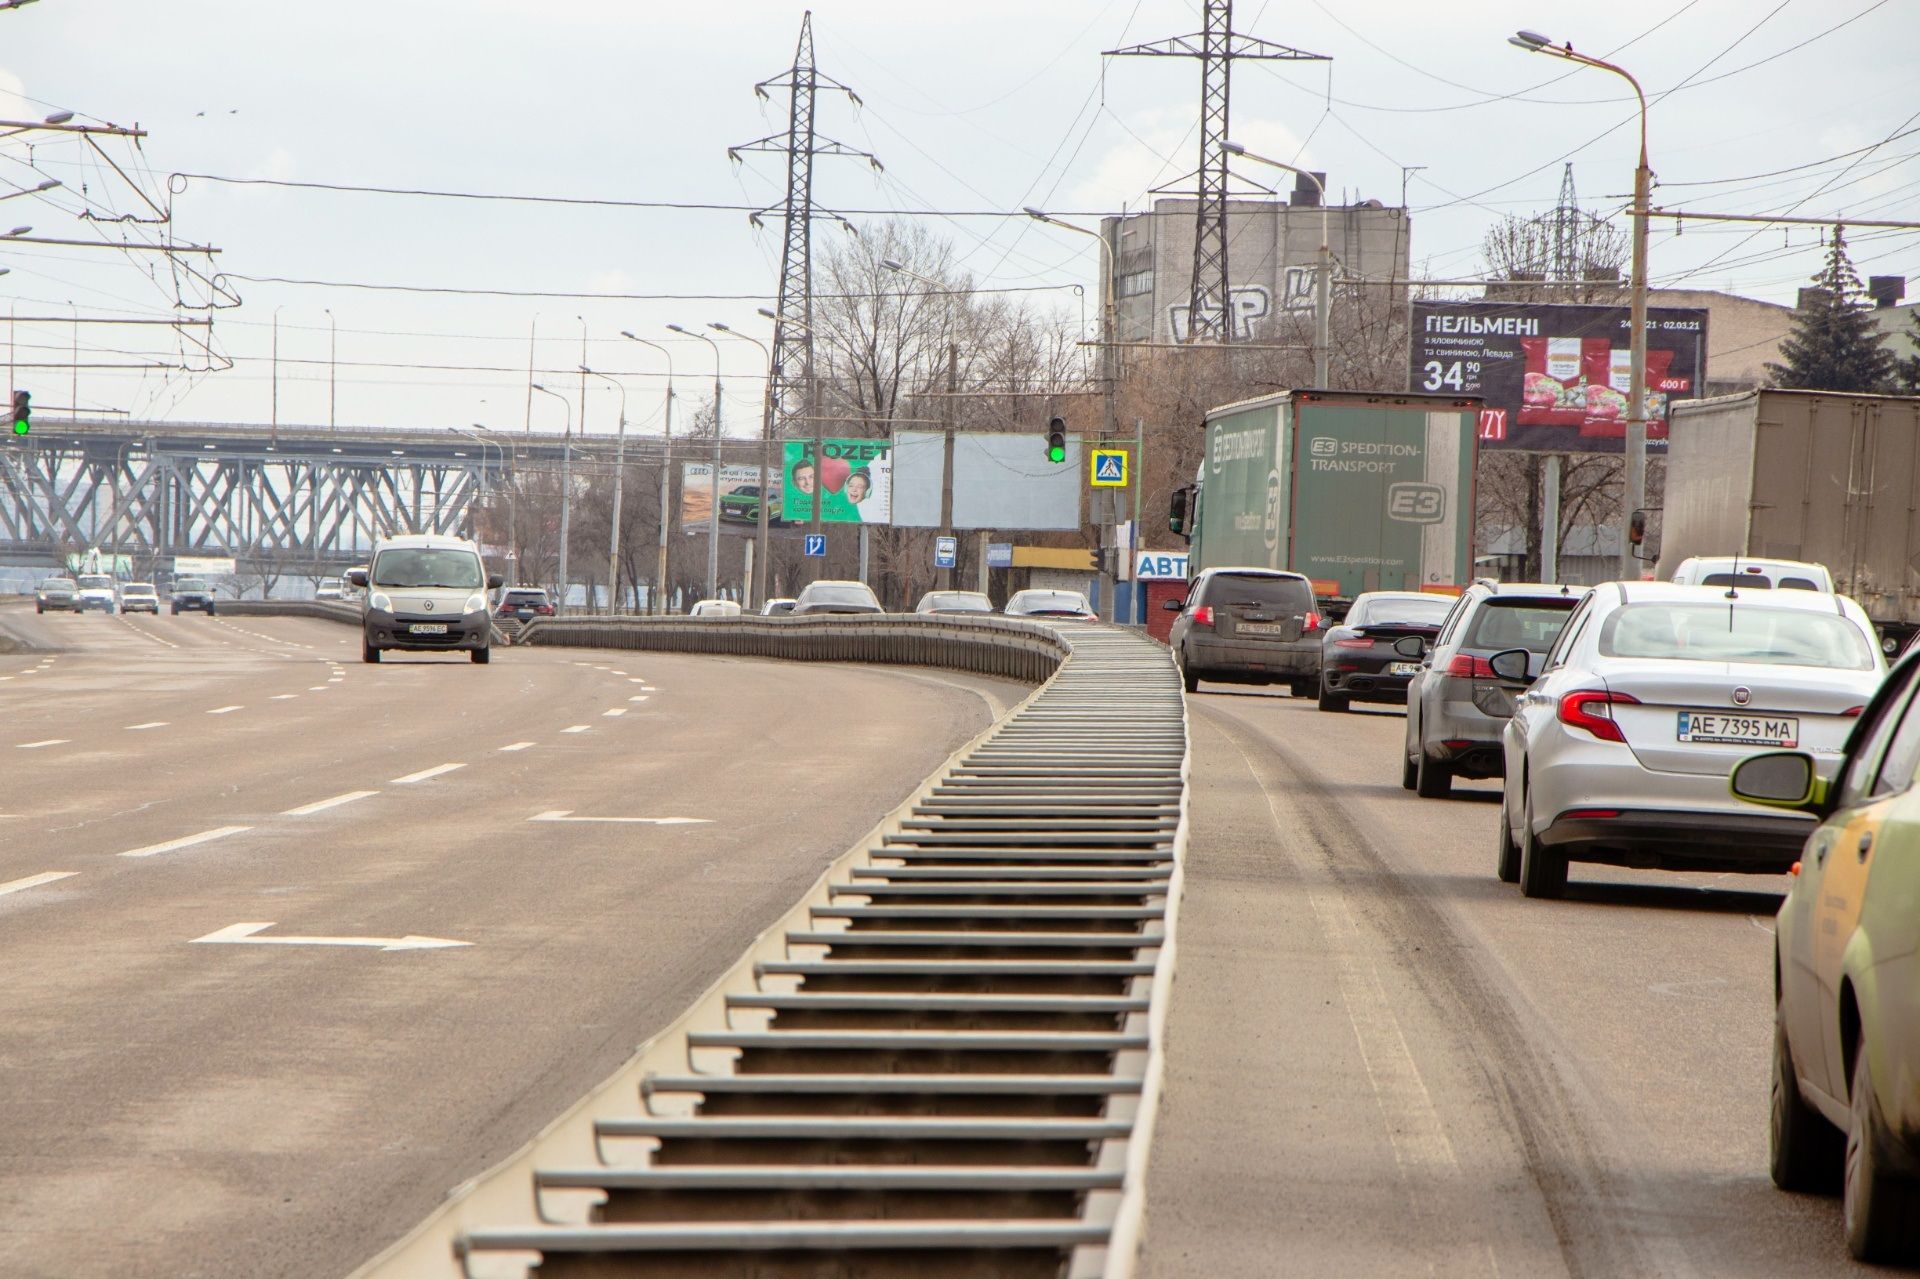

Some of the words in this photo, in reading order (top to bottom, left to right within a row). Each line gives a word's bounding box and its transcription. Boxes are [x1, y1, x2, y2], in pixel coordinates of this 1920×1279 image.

[1425, 315, 1539, 336] ПЕЛЬМЕНІ
[1663, 321, 1700, 330] 02.03.21
[1431, 337, 1485, 346] яловичиною
[1424, 348, 1435, 356] та
[1436, 349, 1481, 358] свининою,
[1423, 360, 1464, 391] 34
[1659, 380, 1678, 389] 400
[1311, 440, 1337, 453] E3
[1341, 441, 1422, 456] SPEDITION-
[1310, 458, 1397, 473] TRANSPORT
[1391, 490, 1441, 514] E3
[1689, 716, 1715, 734] AE
[1720, 718, 1760, 737] 7395
[1764, 720, 1791, 739] MA
